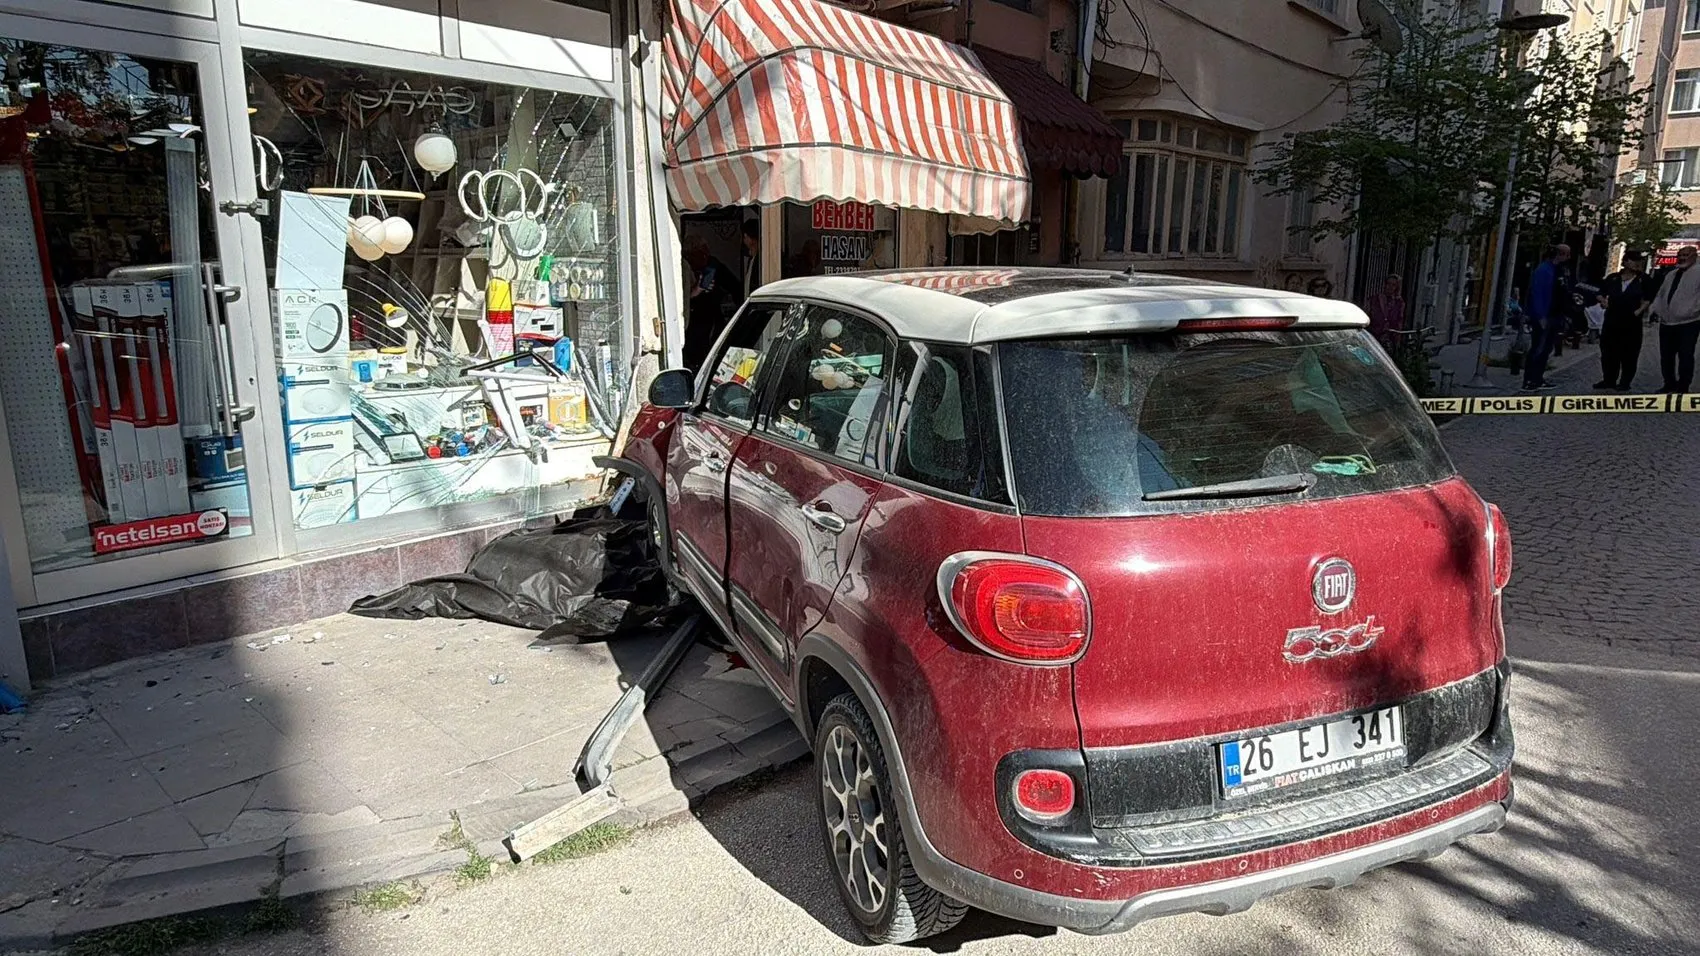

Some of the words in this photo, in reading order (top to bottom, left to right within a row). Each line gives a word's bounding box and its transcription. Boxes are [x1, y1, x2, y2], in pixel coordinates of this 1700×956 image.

[812, 200, 875, 230] BERBER
[821, 235, 866, 260] HASAN
[285, 295, 317, 304] ACK
[1480, 399, 1534, 411] POLİS
[1561, 397, 1659, 410] GİRİLMEZ
[310, 429, 344, 438] SELDUR
[97, 522, 196, 546] netelsan
[1324, 573, 1348, 599] FIAT
[1241, 736, 1274, 777] 26
[1299, 723, 1329, 763] EJ
[1352, 708, 1395, 749] 341
[1227, 764, 1240, 776] TR
